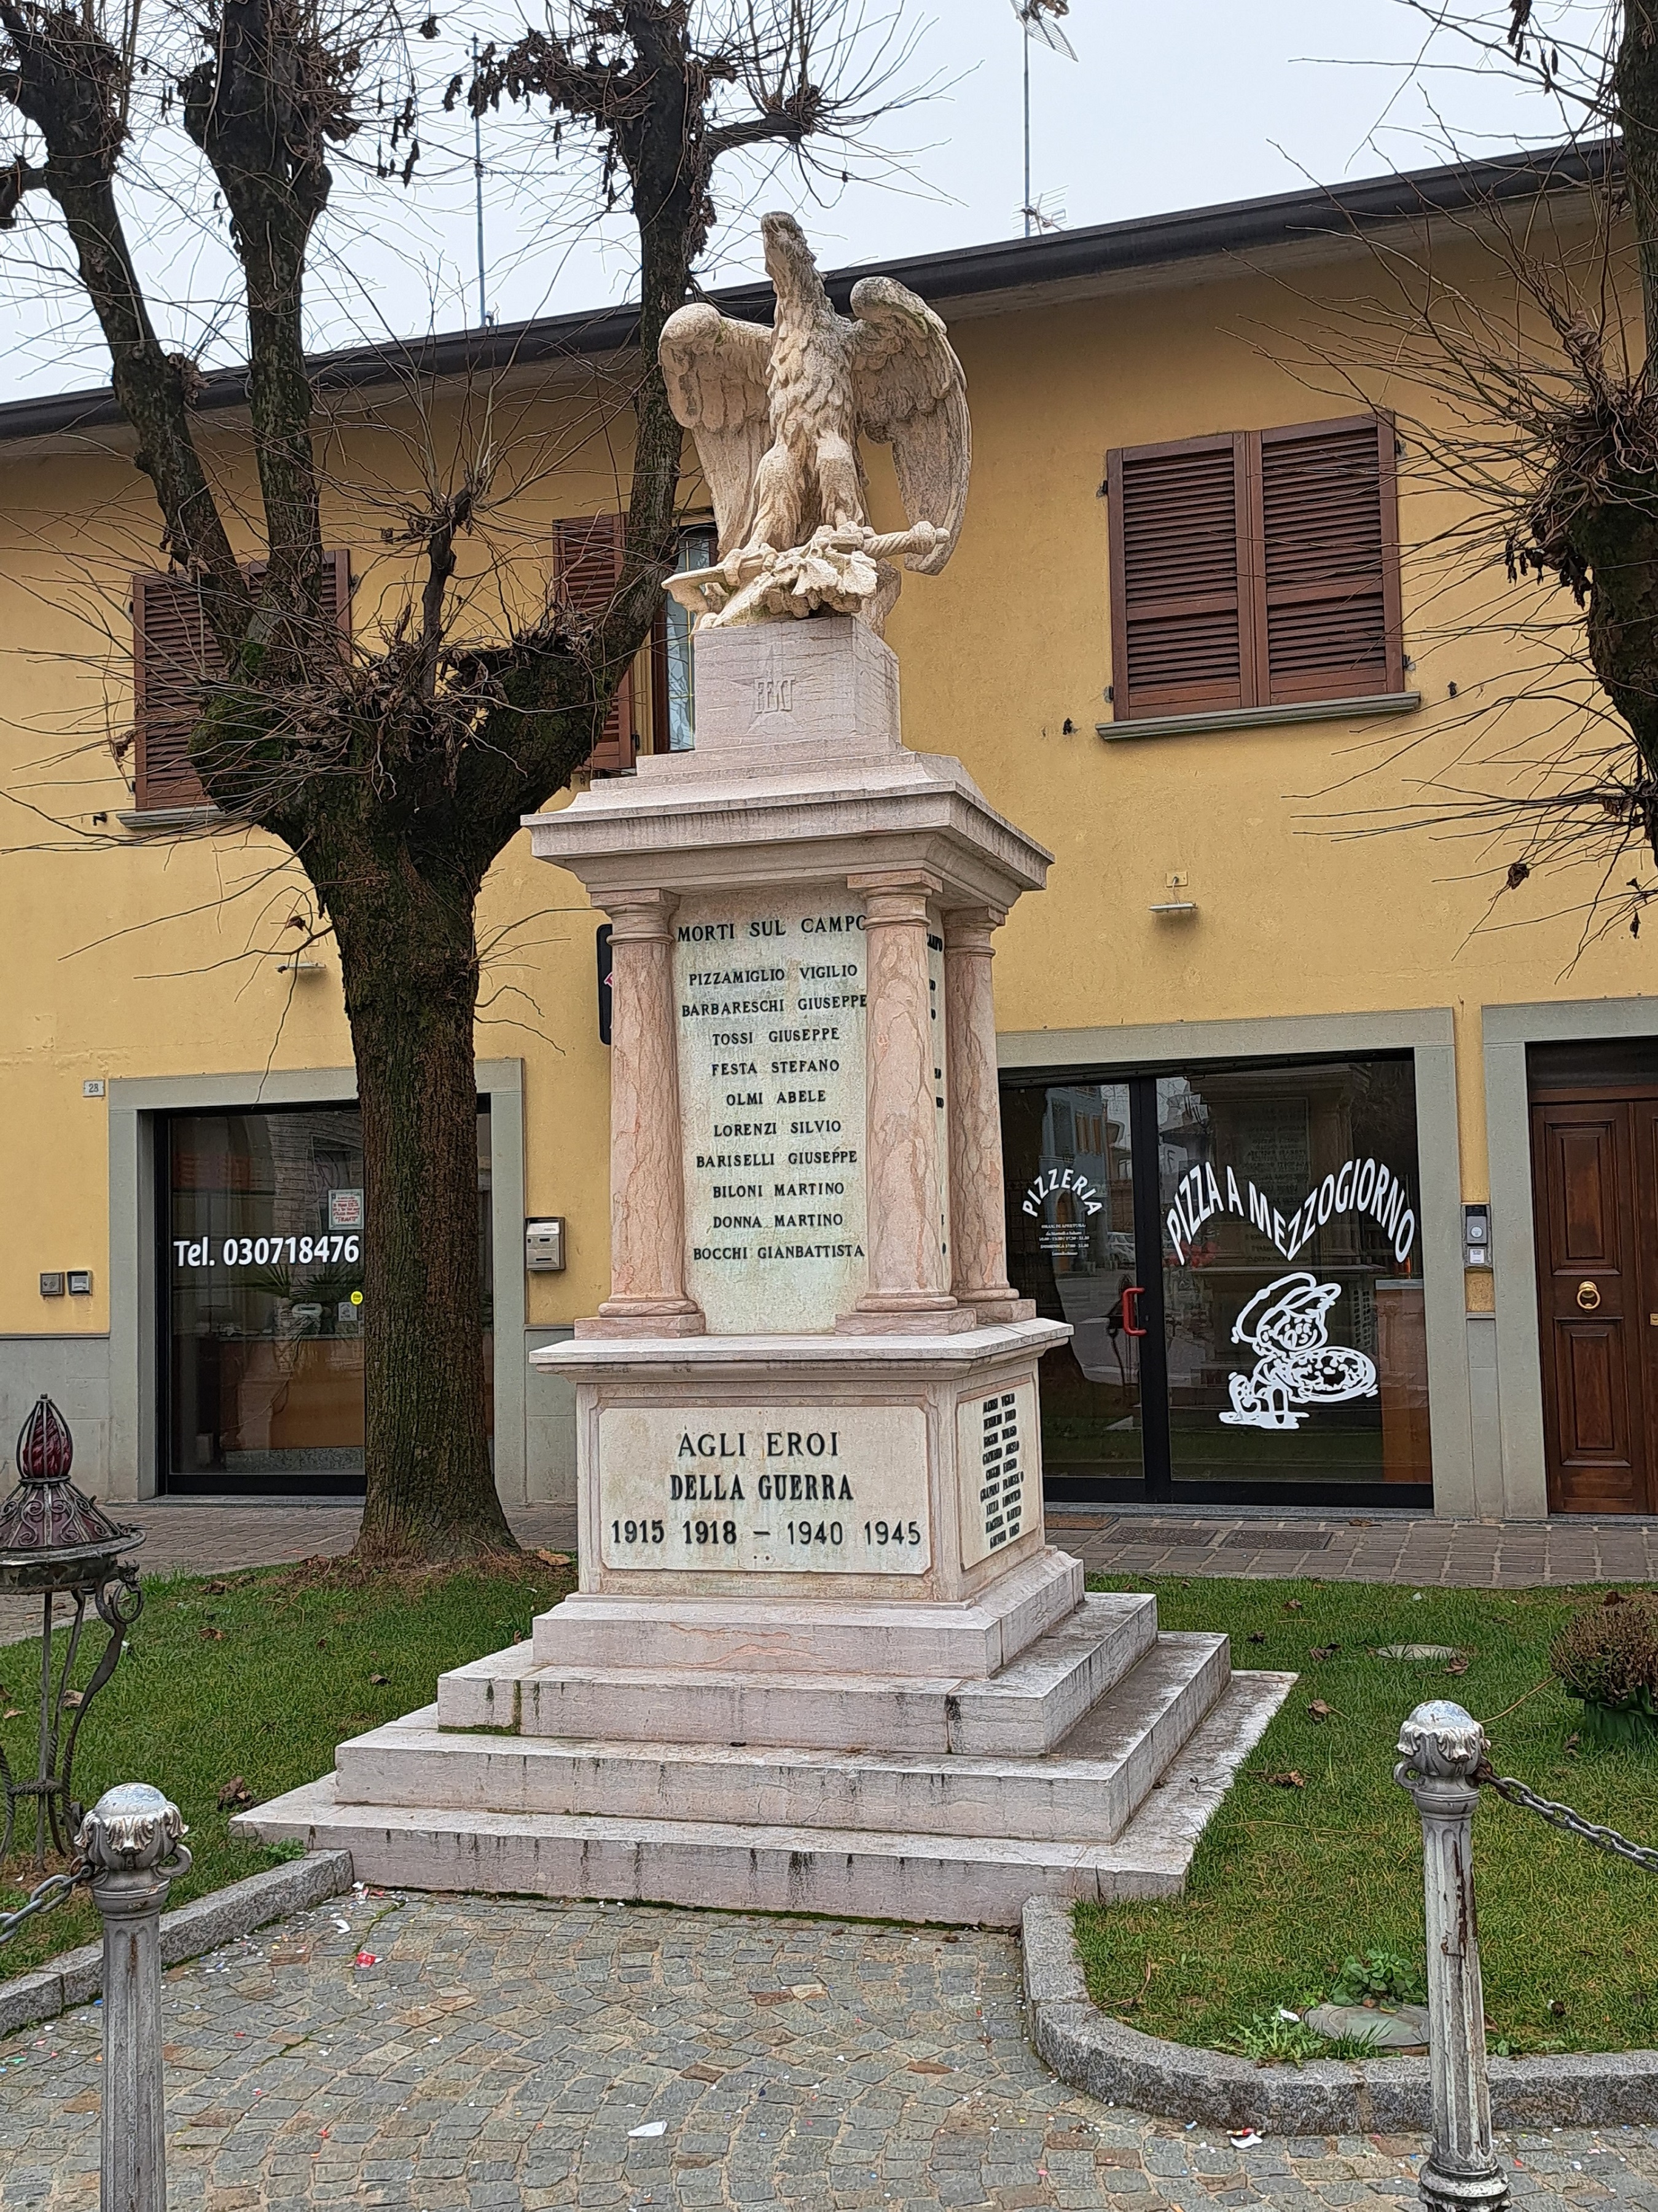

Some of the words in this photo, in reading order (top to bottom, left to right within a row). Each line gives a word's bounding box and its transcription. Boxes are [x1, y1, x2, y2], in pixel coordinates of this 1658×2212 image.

[677, 923, 735, 943] MORTI
[749, 919, 786, 937] SUL
[801, 914, 868, 933] CAMPO
[689, 968, 785, 986] PIZZAMIGLIO
[799, 964, 858, 979] VIGILIO
[682, 999, 784, 1017] BARBARESCHI
[797, 994, 867, 1010] GIUSEPPE
[712, 1032, 753, 1046] TOSSI
[768, 1027, 840, 1042] GIUSEPPE
[712, 1062, 757, 1076] FESTA
[772, 1059, 840, 1073] STEFANO
[88, 1083, 99, 1092] 28
[726, 1092, 763, 1106] OLMI
[776, 1090, 826, 1104] ABELE
[714, 1123, 777, 1137] LORENZI
[791, 1120, 841, 1134] SILVIO
[697, 1153, 774, 1168] BARISELLI
[788, 1150, 857, 1164] GIUSEPPE
[713, 1185, 762, 1198] BILONI
[774, 1182, 844, 1196] MARTINO
[1022, 1168, 1103, 1217] PIZZERIA
[713, 1216, 762, 1228] DONNA
[775, 1214, 843, 1227] MARTINO
[1167, 1161, 1224, 1265] PIZZA
[1227, 1166, 1245, 1217] A
[1249, 1158, 1415, 1263] MEZZOGIORNO
[173, 1236, 215, 1266] Tel.
[223, 1235, 359, 1266] 030718476
[693, 1247, 747, 1260] BOCCHI
[757, 1244, 865, 1259] GIANBATTISTA
[678, 1433, 745, 1457] AGLI
[767, 1432, 838, 1456] EROI
[670, 1474, 745, 1500] DELLA
[758, 1474, 854, 1500] GUERRA
[612, 1520, 664, 1543] 1915
[682, 1520, 737, 1544] 1918
[788, 1521, 843, 1545] 1940
[864, 1521, 920, 1545] 1945
